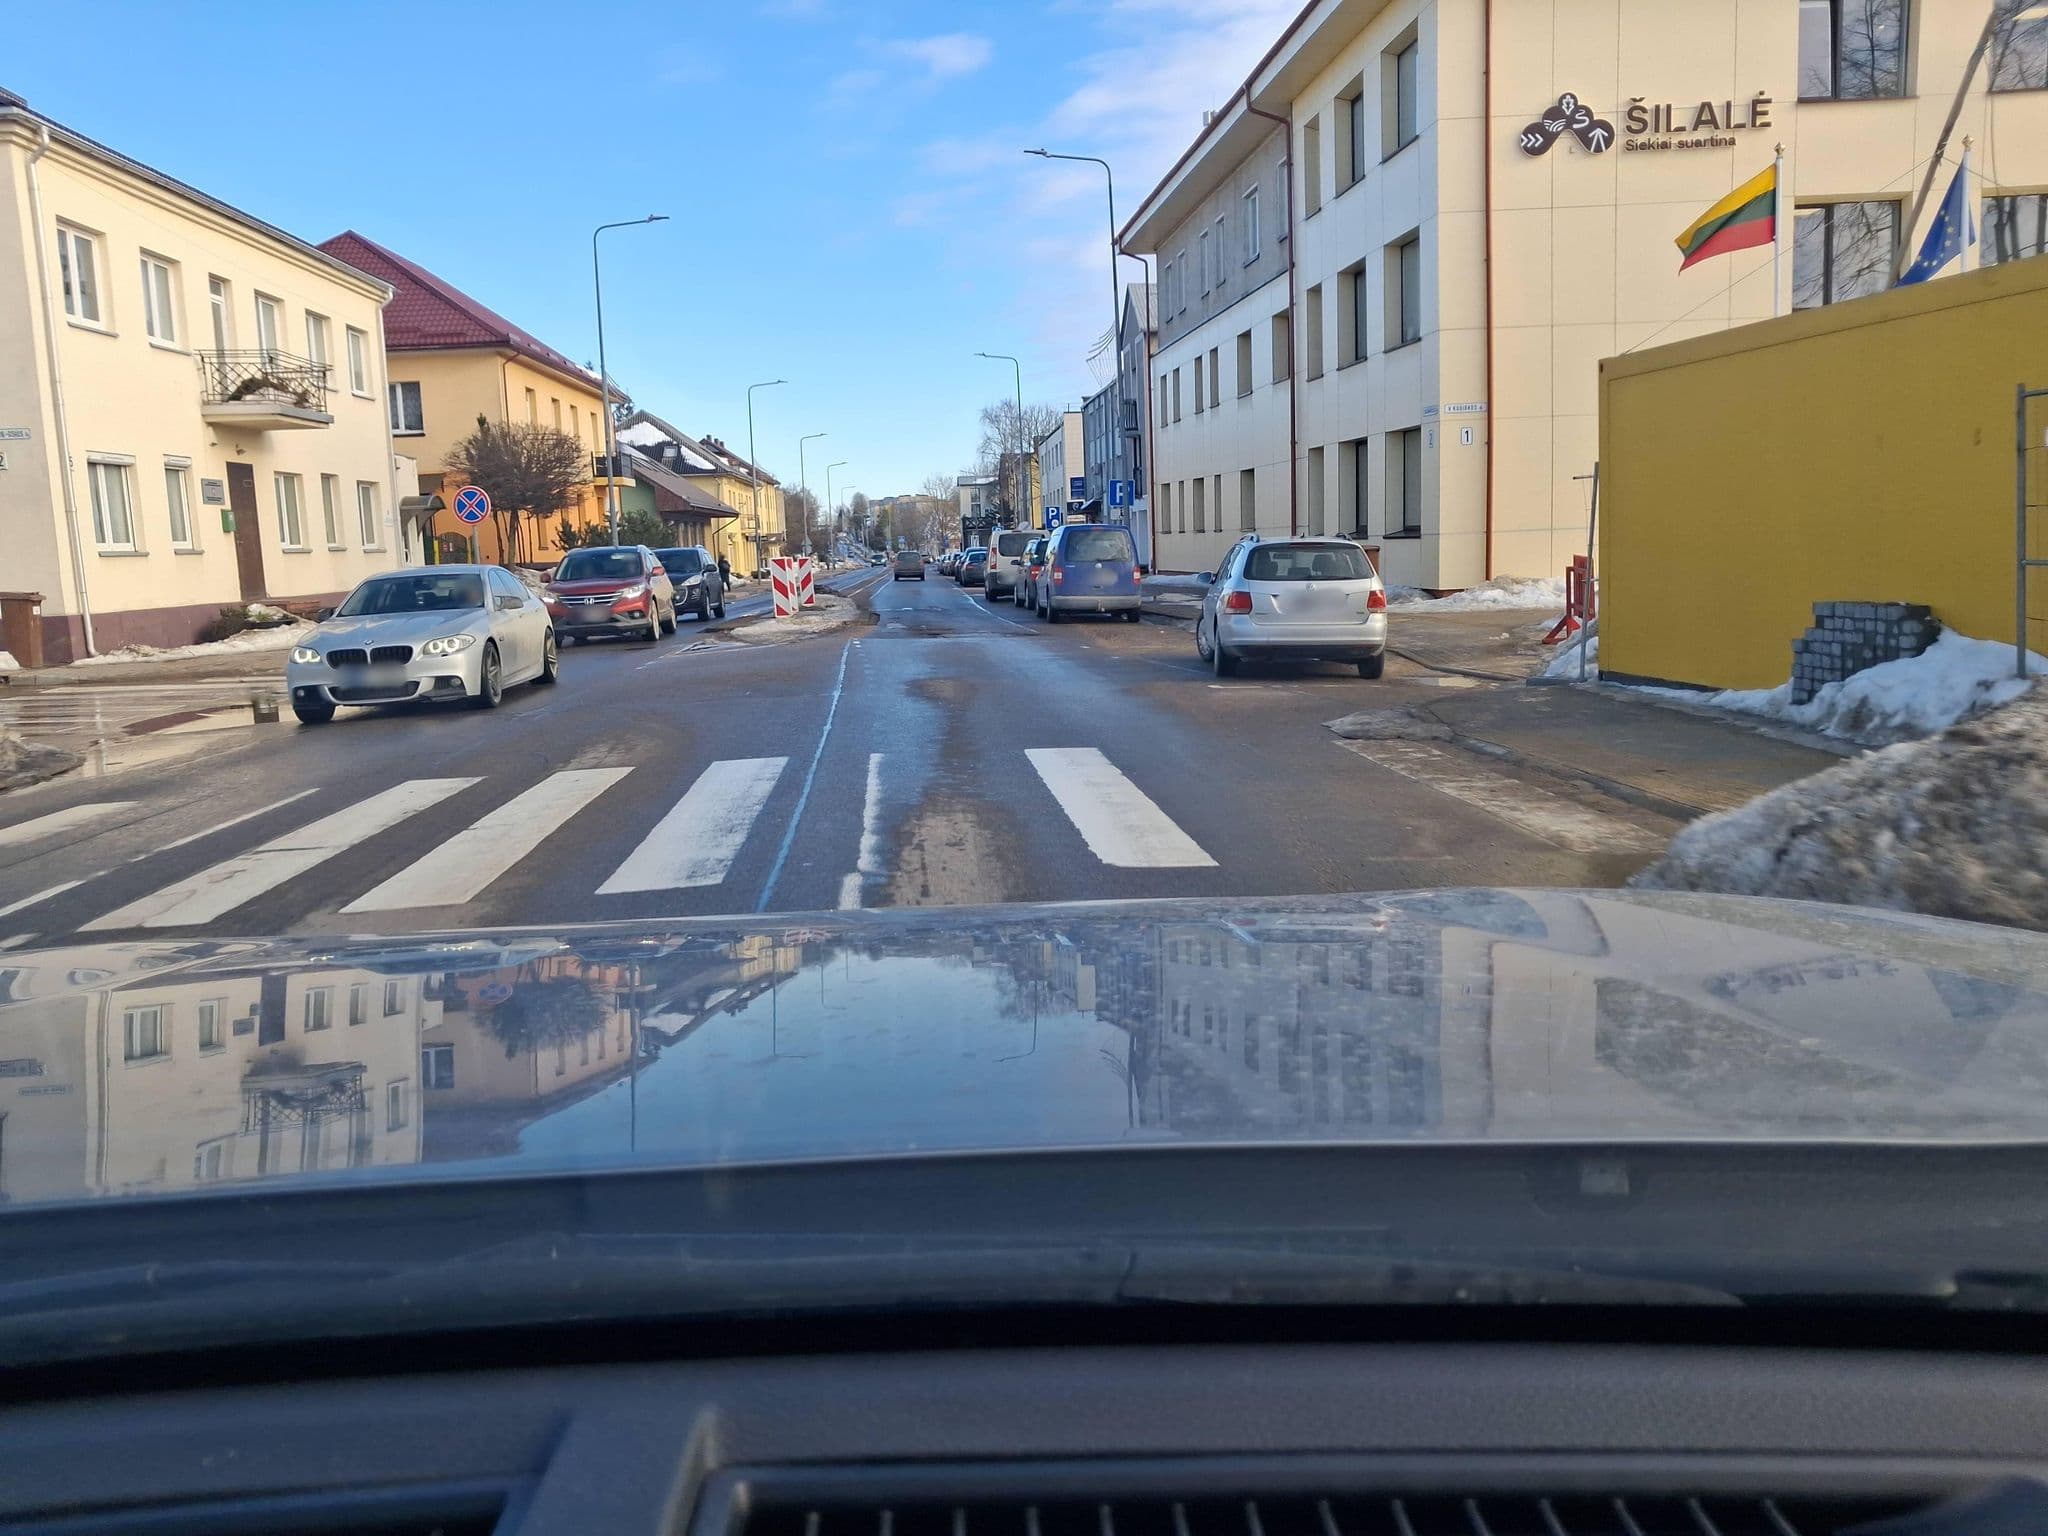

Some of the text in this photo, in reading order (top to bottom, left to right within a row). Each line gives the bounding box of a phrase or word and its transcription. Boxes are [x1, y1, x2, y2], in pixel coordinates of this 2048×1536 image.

[1626, 90, 1773, 134] ŠILALĖ
[1625, 135, 1736, 152] Siekiai suartina
[1464, 429, 1471, 443] 1
[1048, 508, 1057, 520] P
